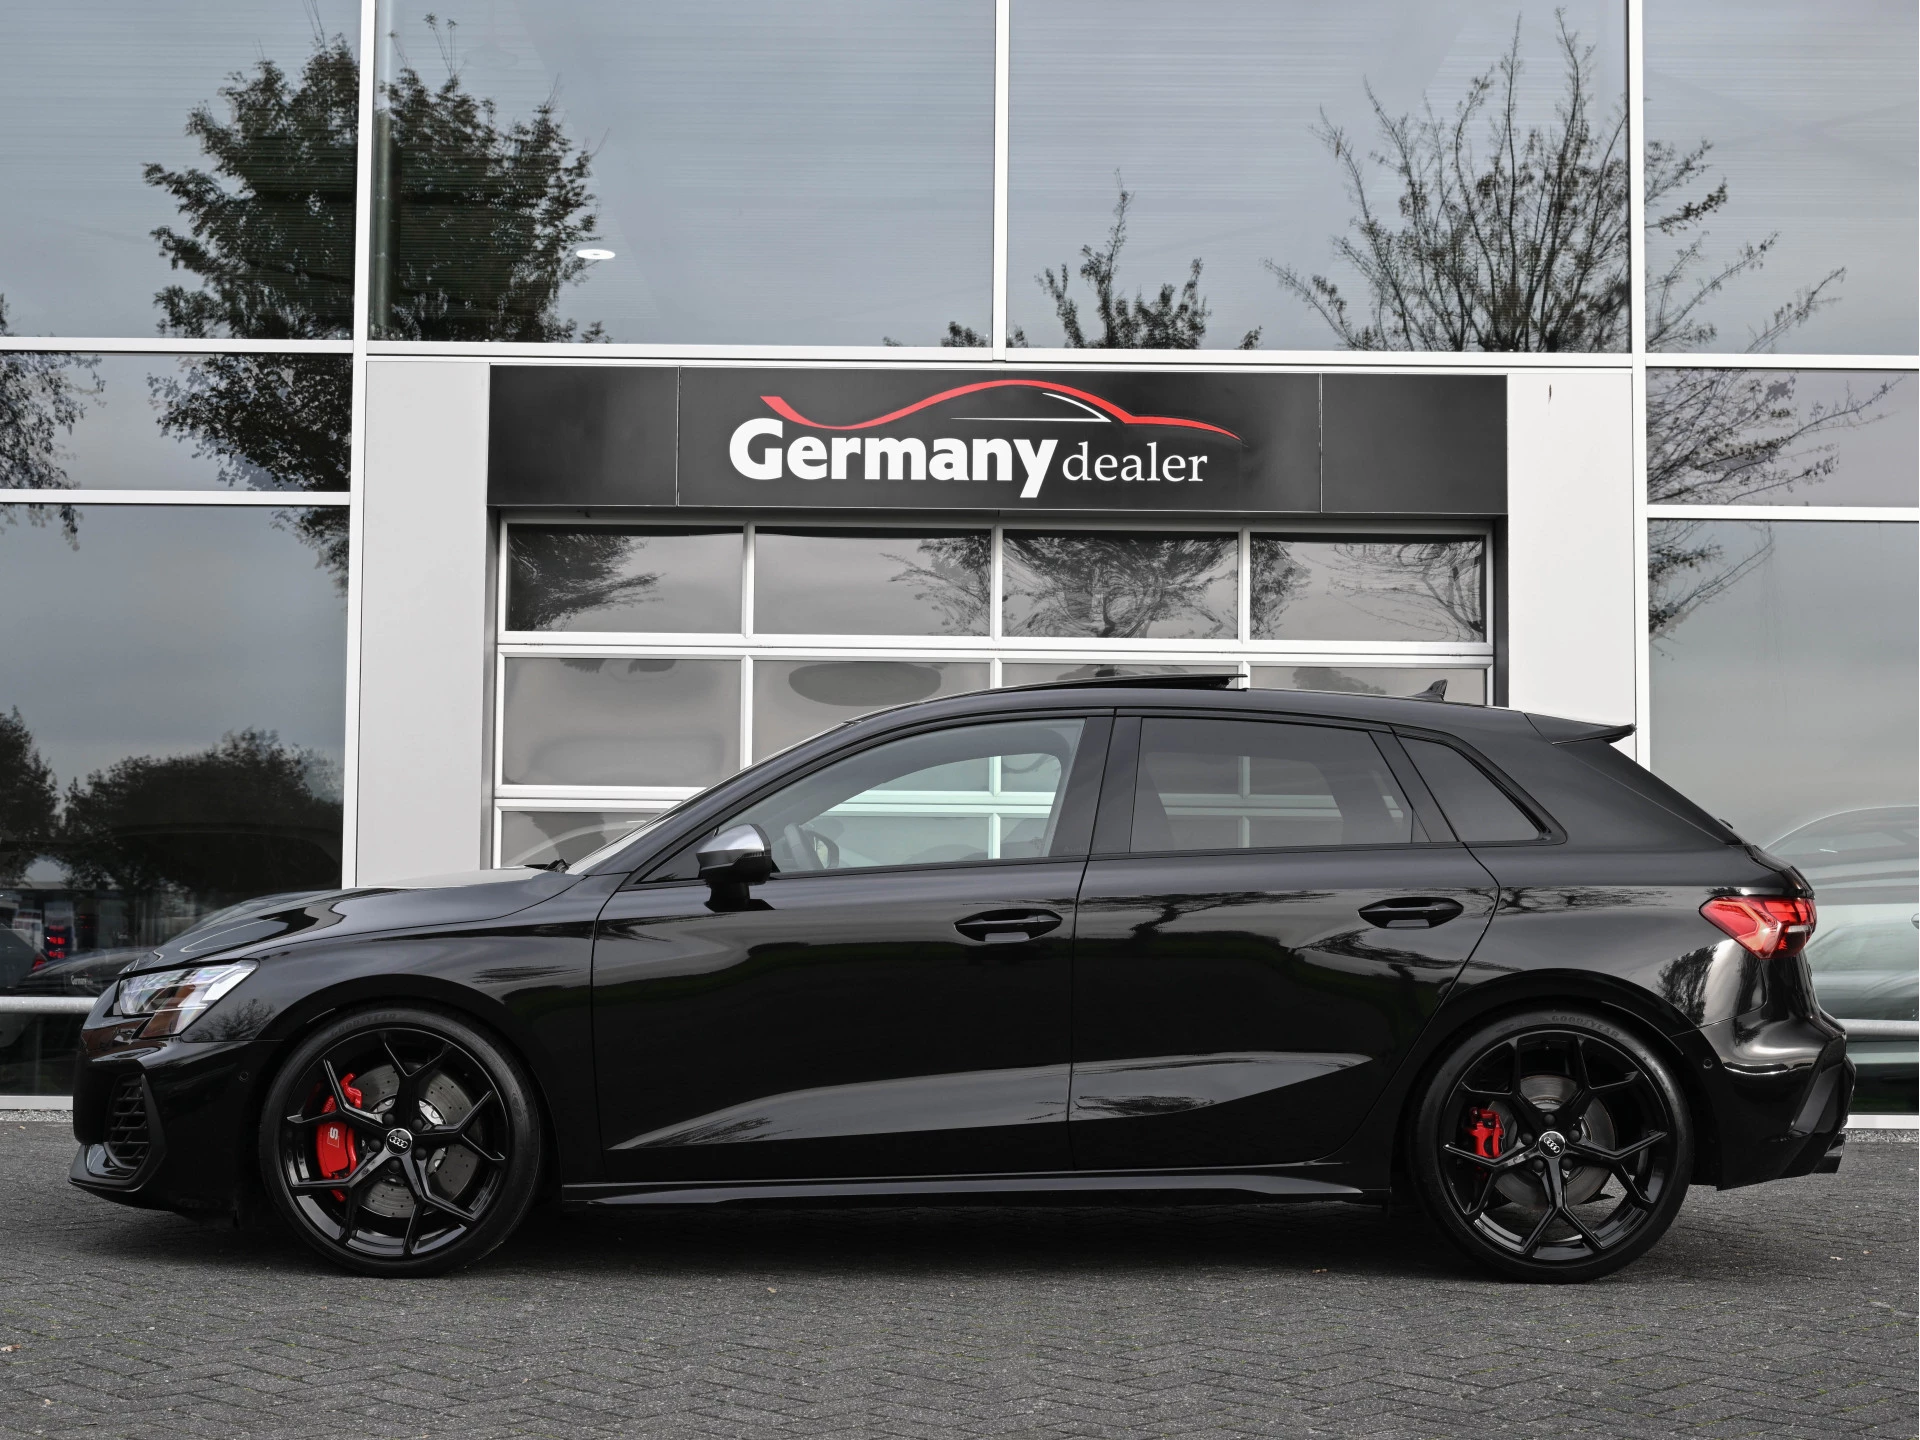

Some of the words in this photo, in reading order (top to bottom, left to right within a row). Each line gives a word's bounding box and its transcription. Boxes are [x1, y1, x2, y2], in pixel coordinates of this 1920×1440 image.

[729, 417, 1058, 498] Germany
[1062, 442, 1208, 483] dealer
[1551, 1014, 1620, 1038] GOODYEAR
